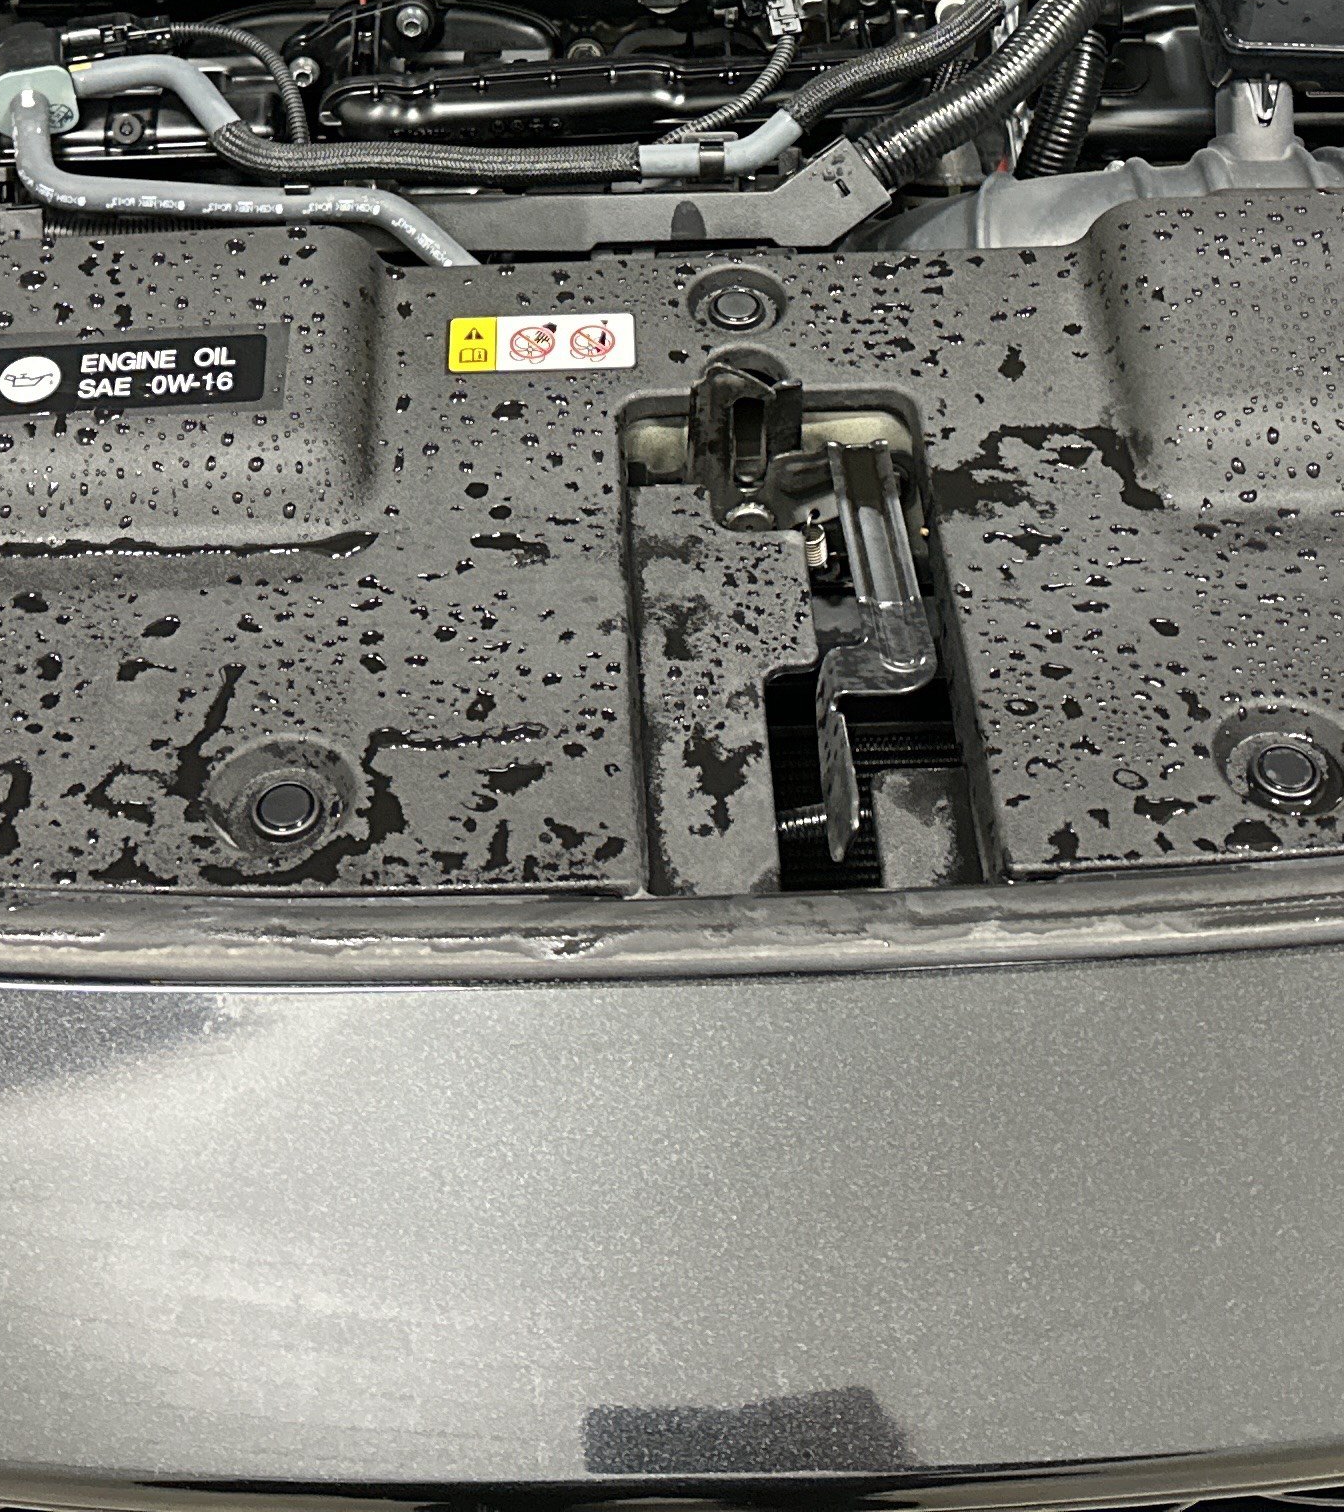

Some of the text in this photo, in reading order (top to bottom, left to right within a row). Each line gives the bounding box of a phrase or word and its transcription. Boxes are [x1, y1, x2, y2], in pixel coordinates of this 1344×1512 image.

[80, 346, 236, 374] ENGINE OIL
[77, 371, 234, 399] SAE 0W-16
